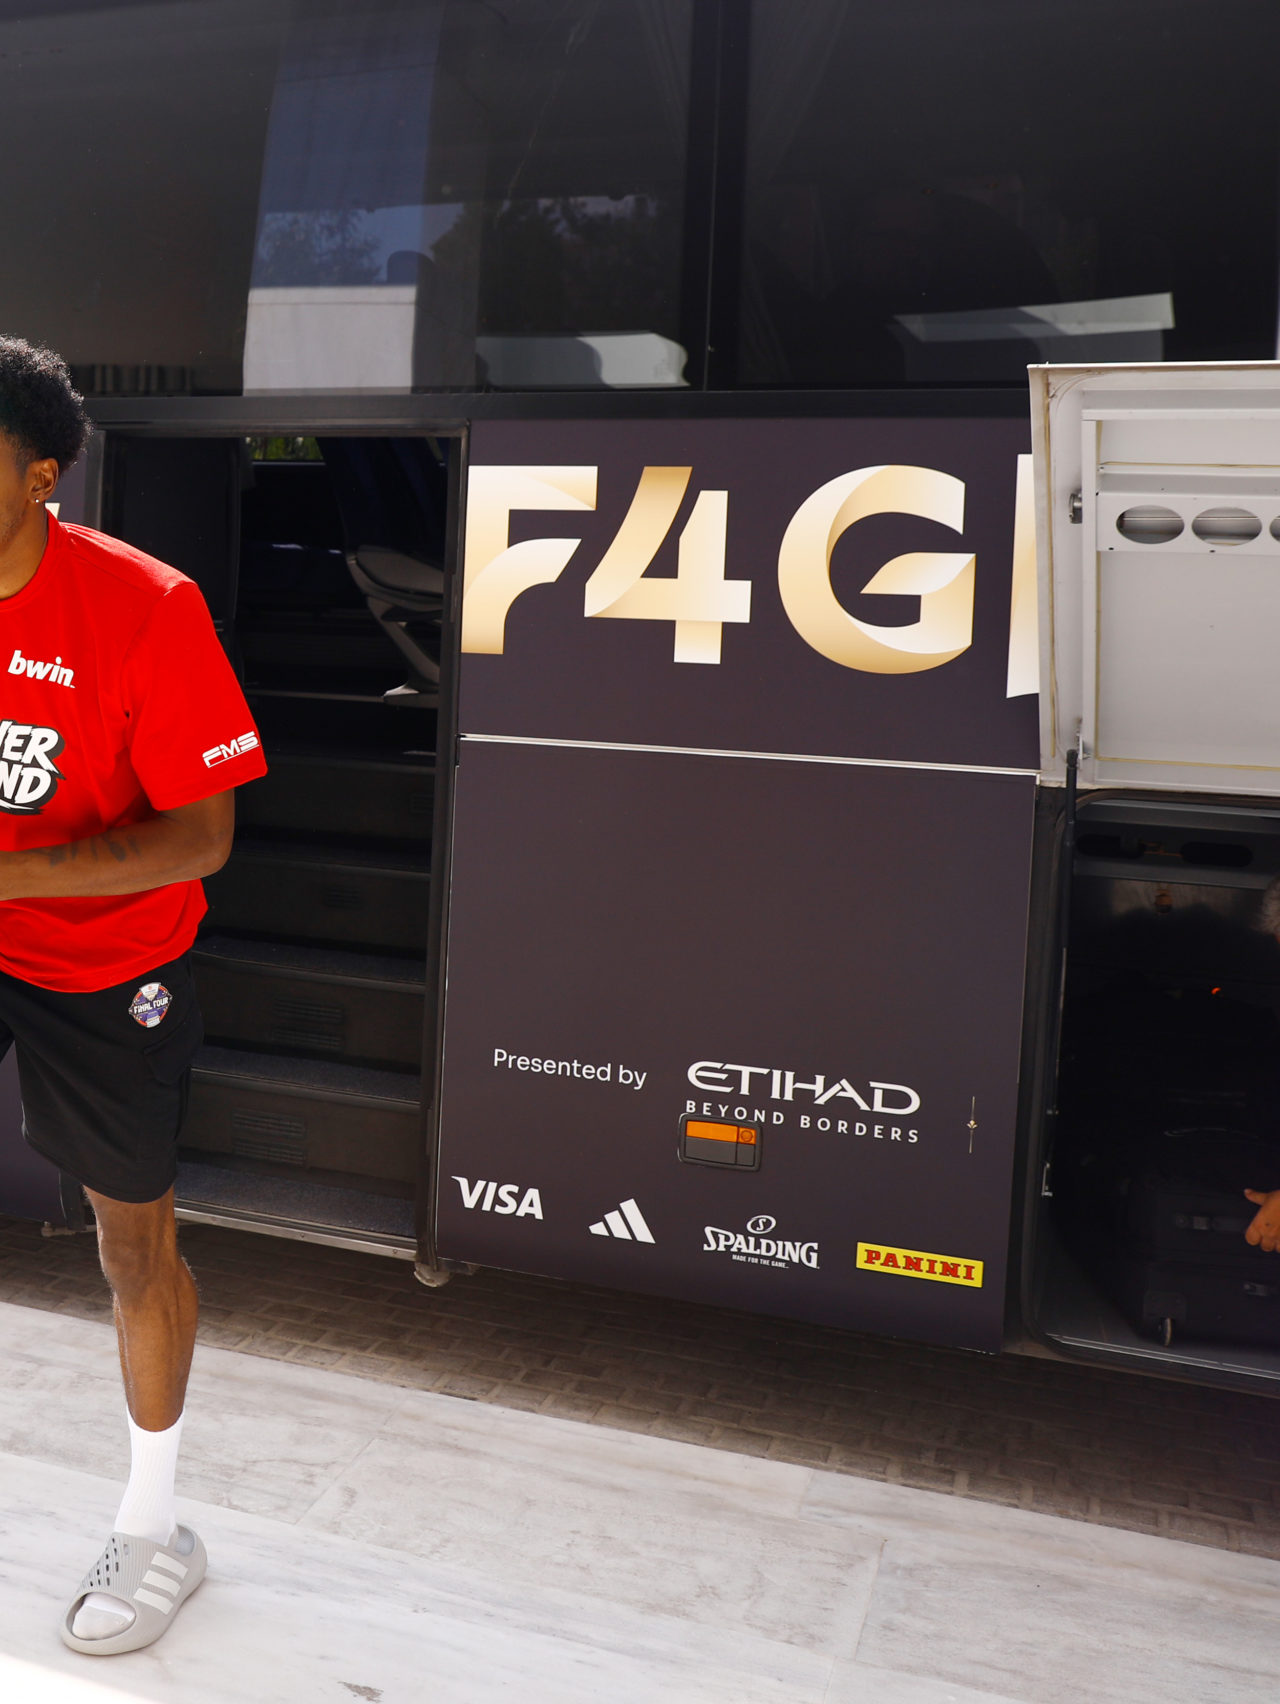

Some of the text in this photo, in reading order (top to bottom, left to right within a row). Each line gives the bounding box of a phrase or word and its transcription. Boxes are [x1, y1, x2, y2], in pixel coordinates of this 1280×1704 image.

[7, 649, 75, 689] bwin
[202, 730, 260, 769] FMS
[133, 1002, 152, 1014] FINAL
[493, 1048, 647, 1090] Presented by
[687, 1060, 921, 1116] ETIHAD
[686, 1099, 919, 1144] BEYOND BORDERS
[451, 1175, 544, 1221] VISA
[703, 1226, 819, 1270] SPALDING
[732, 1254, 746, 1262] MADE
[759, 1258, 770, 1266] THE
[864, 1248, 976, 1281] PANINI
